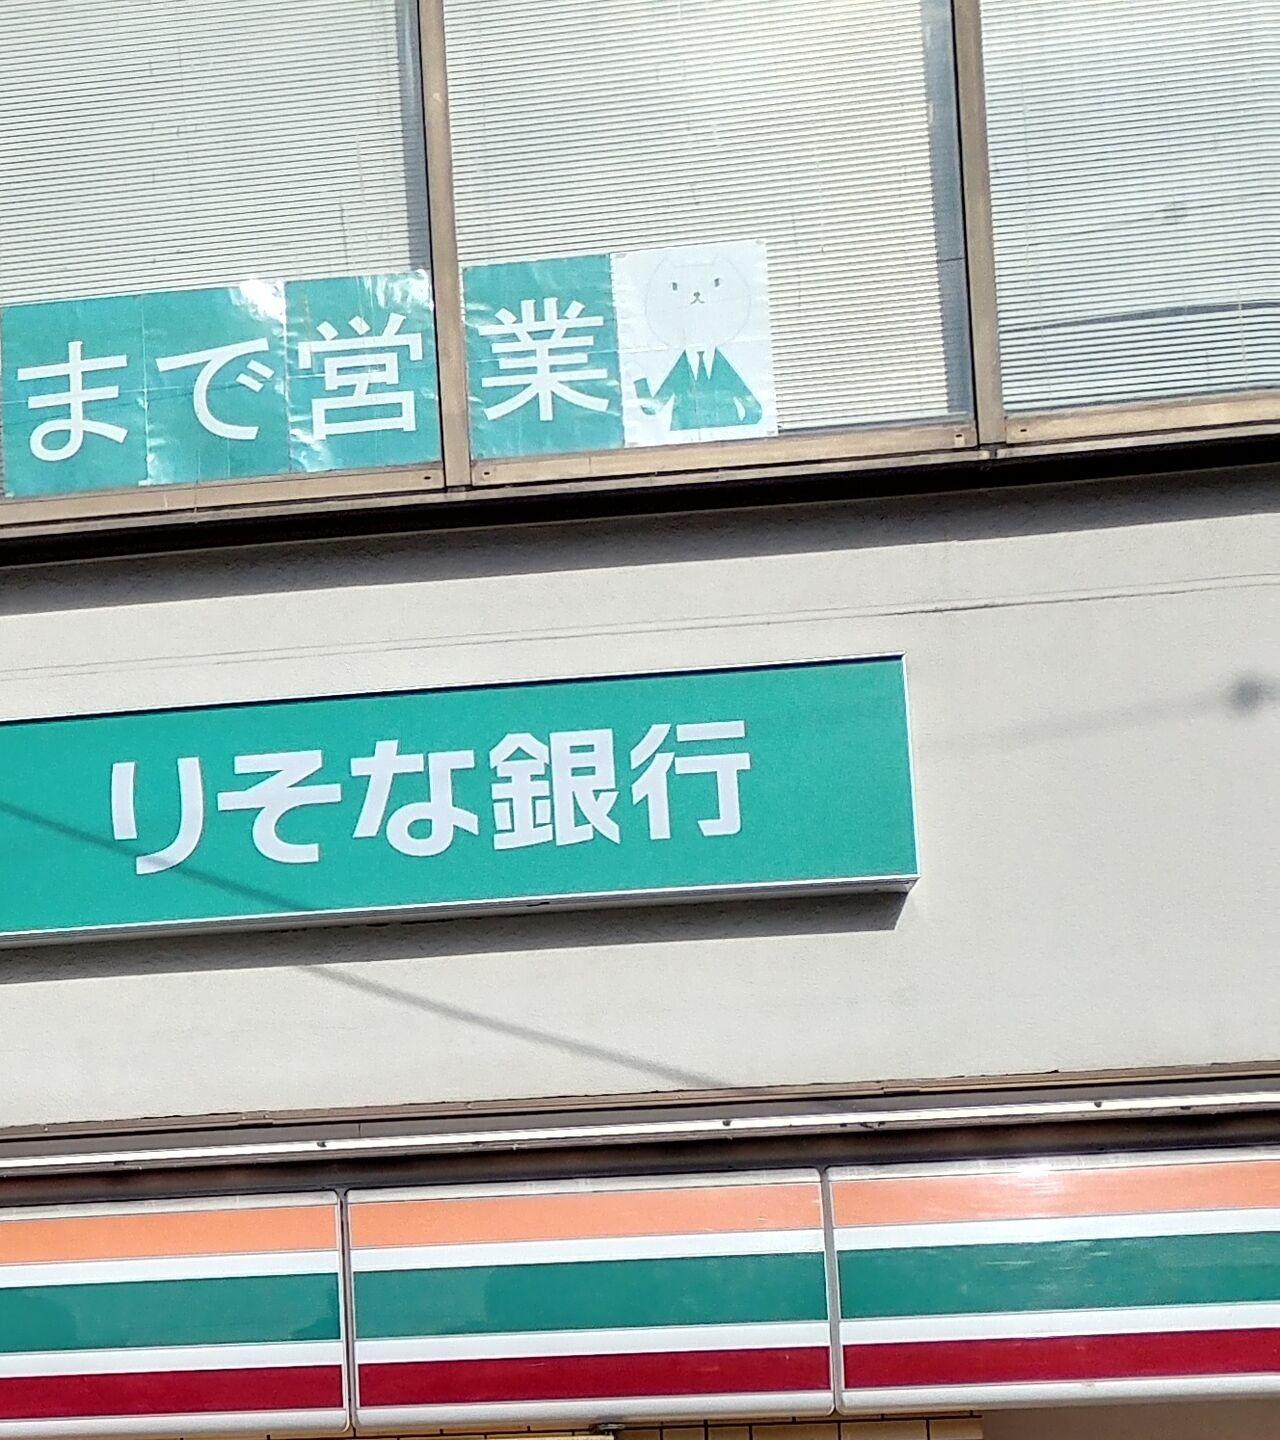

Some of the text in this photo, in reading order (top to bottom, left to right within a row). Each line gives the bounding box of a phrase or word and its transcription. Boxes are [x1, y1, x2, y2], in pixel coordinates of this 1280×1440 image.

[108, 720, 752, 876] りそな銀行
